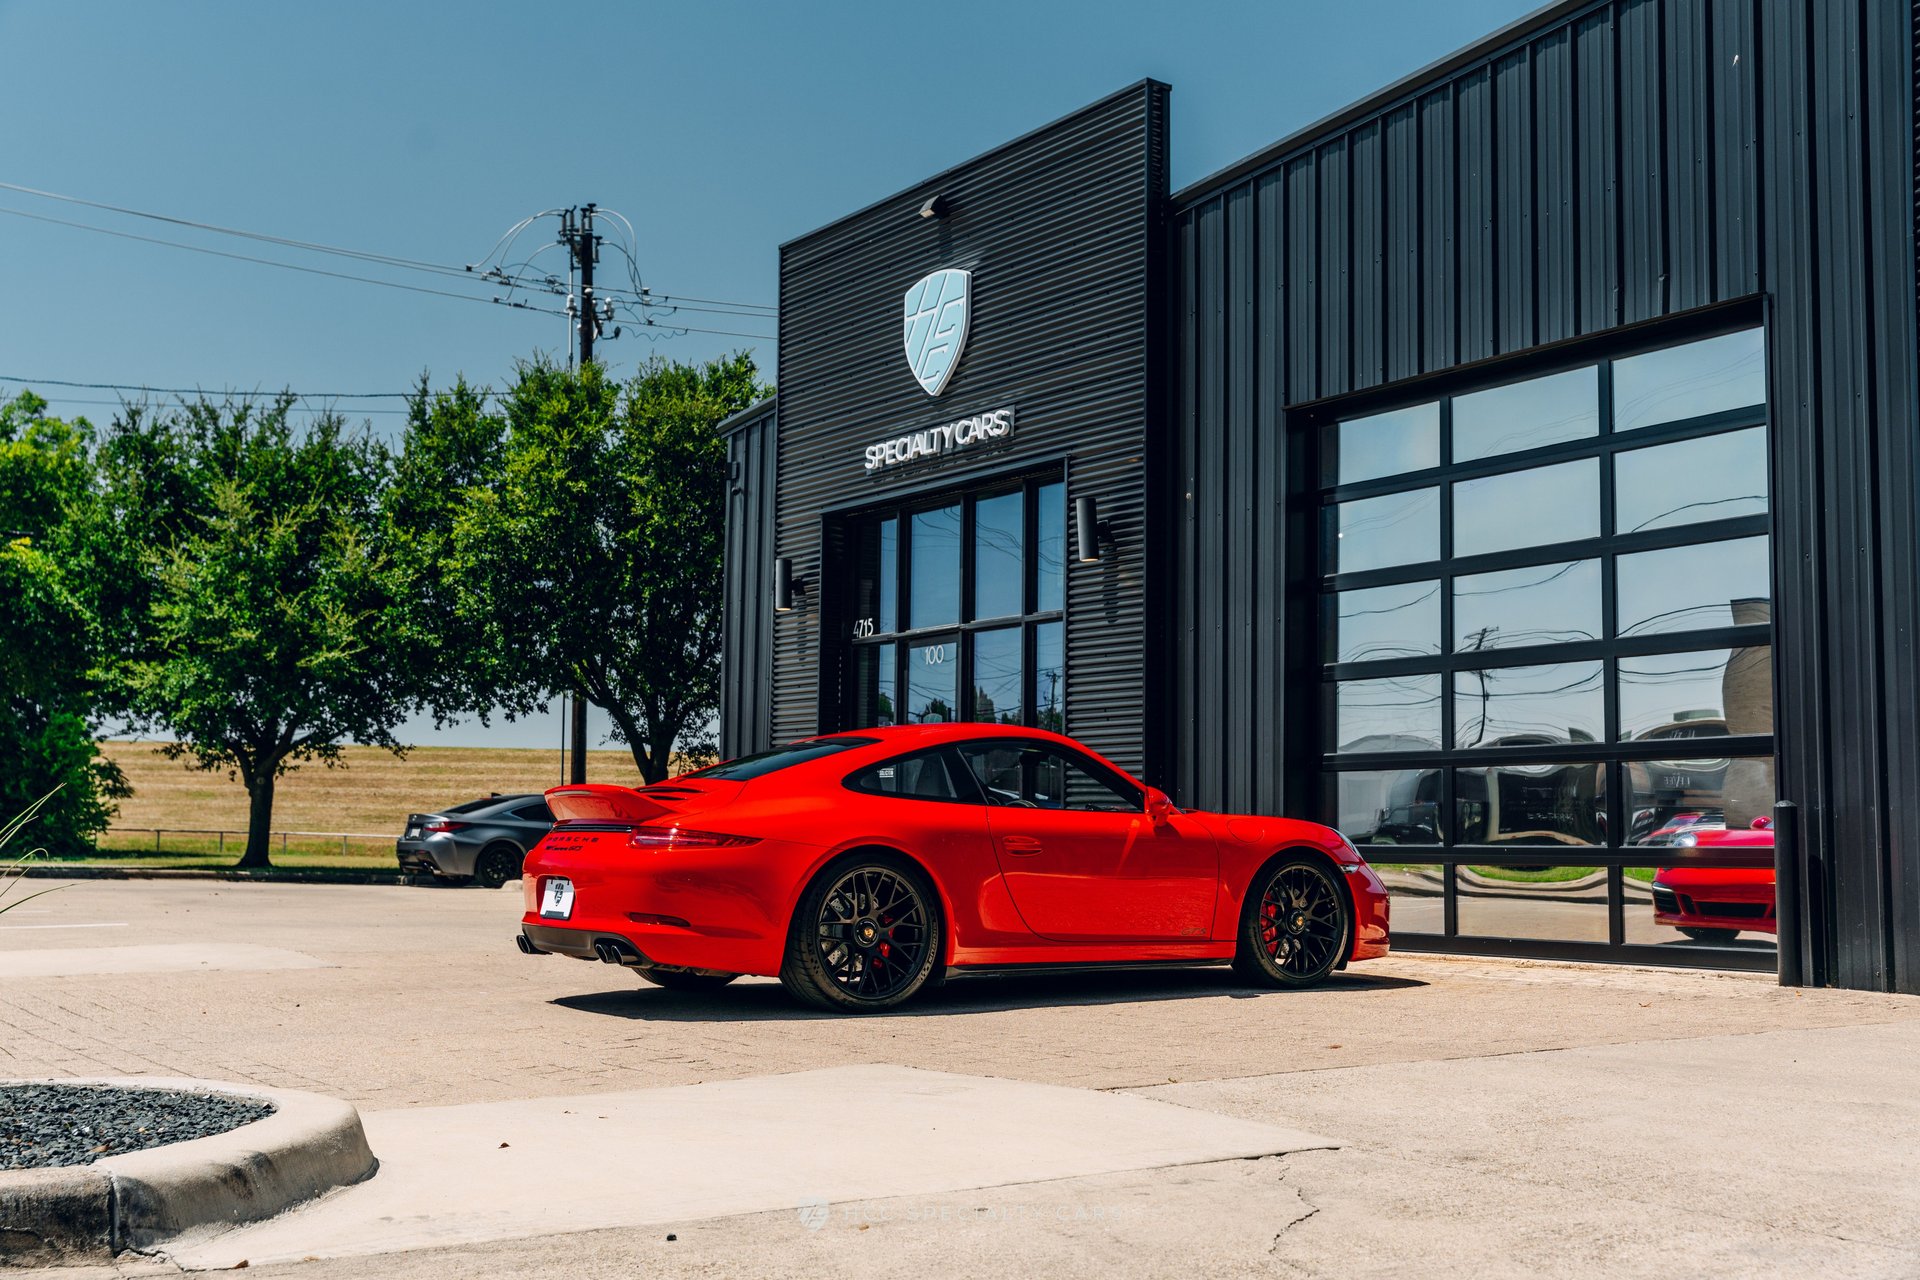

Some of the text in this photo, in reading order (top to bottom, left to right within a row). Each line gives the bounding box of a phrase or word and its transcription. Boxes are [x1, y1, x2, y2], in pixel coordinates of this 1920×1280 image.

[865, 410, 1011, 469] SPECIALTY CARS
[853, 618, 874, 638] 4715
[925, 645, 944, 665] 100
